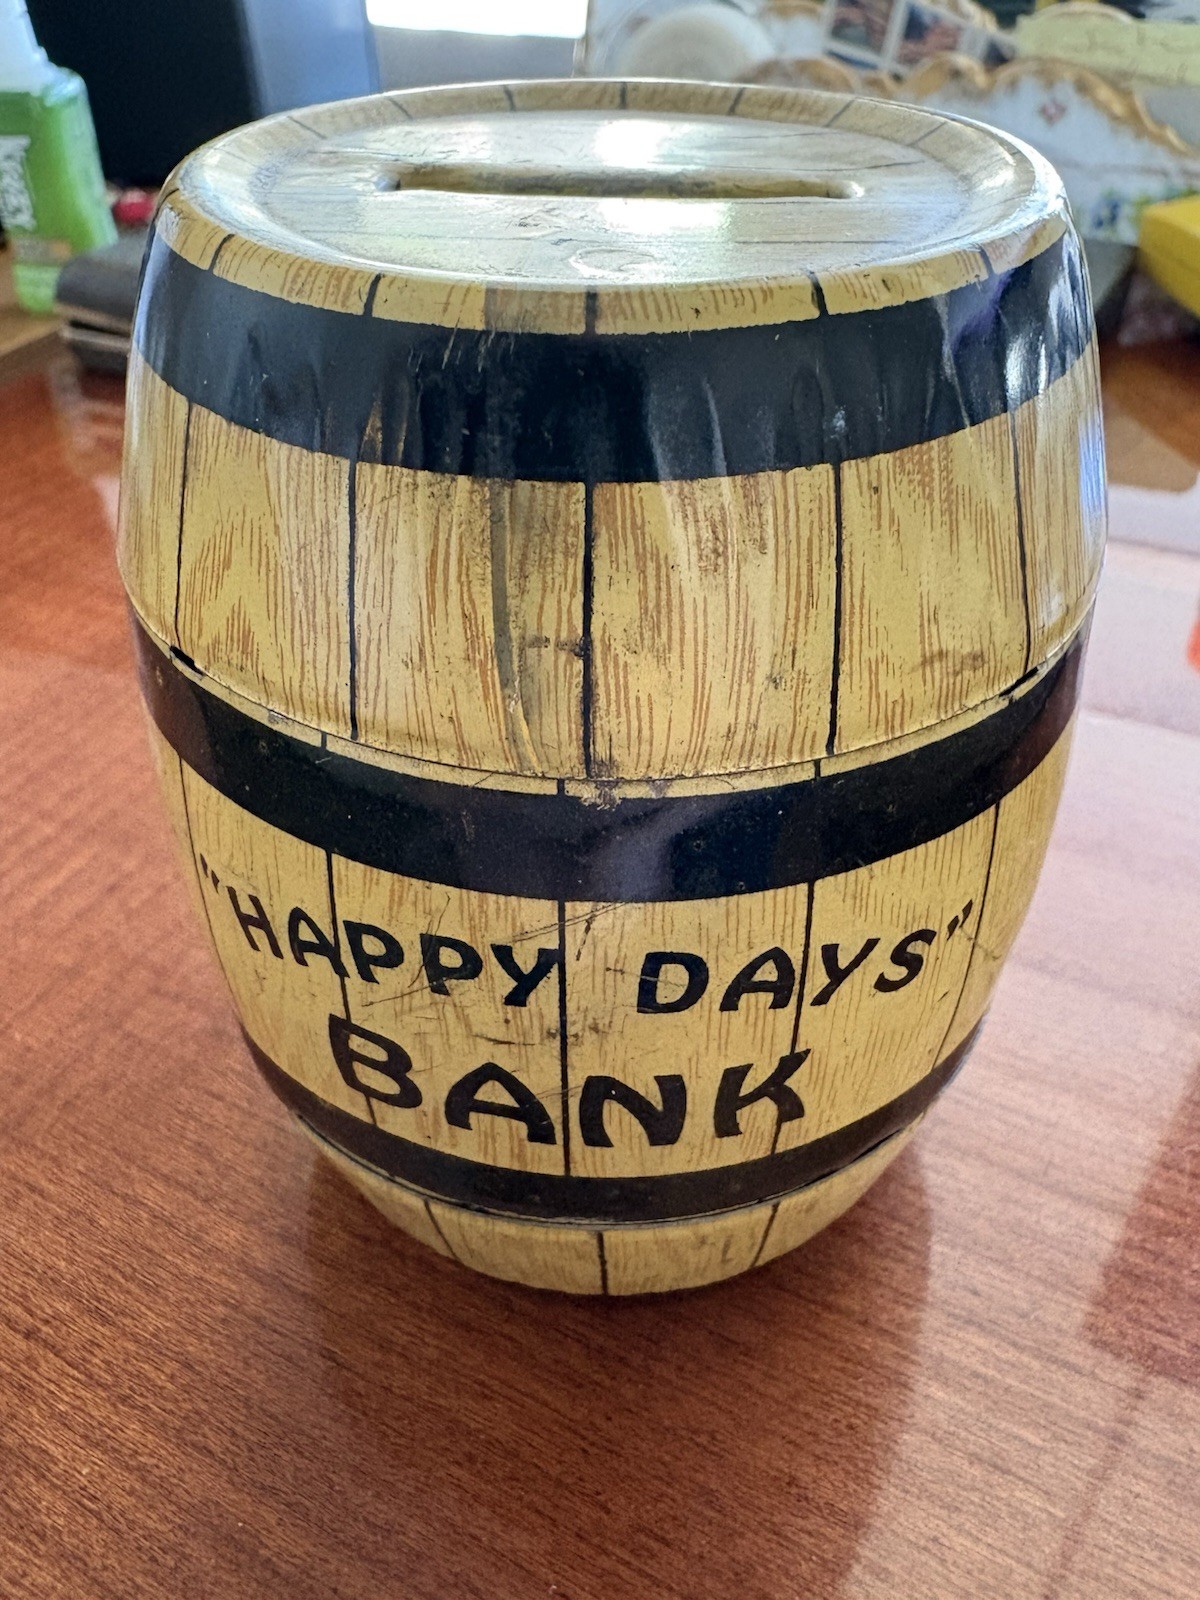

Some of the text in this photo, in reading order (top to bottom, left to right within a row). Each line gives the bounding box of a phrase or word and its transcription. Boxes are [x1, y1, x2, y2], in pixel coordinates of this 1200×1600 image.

[200, 853, 973, 1014] "HAPPY DAYS"
[329, 1013, 811, 1148] BANK
